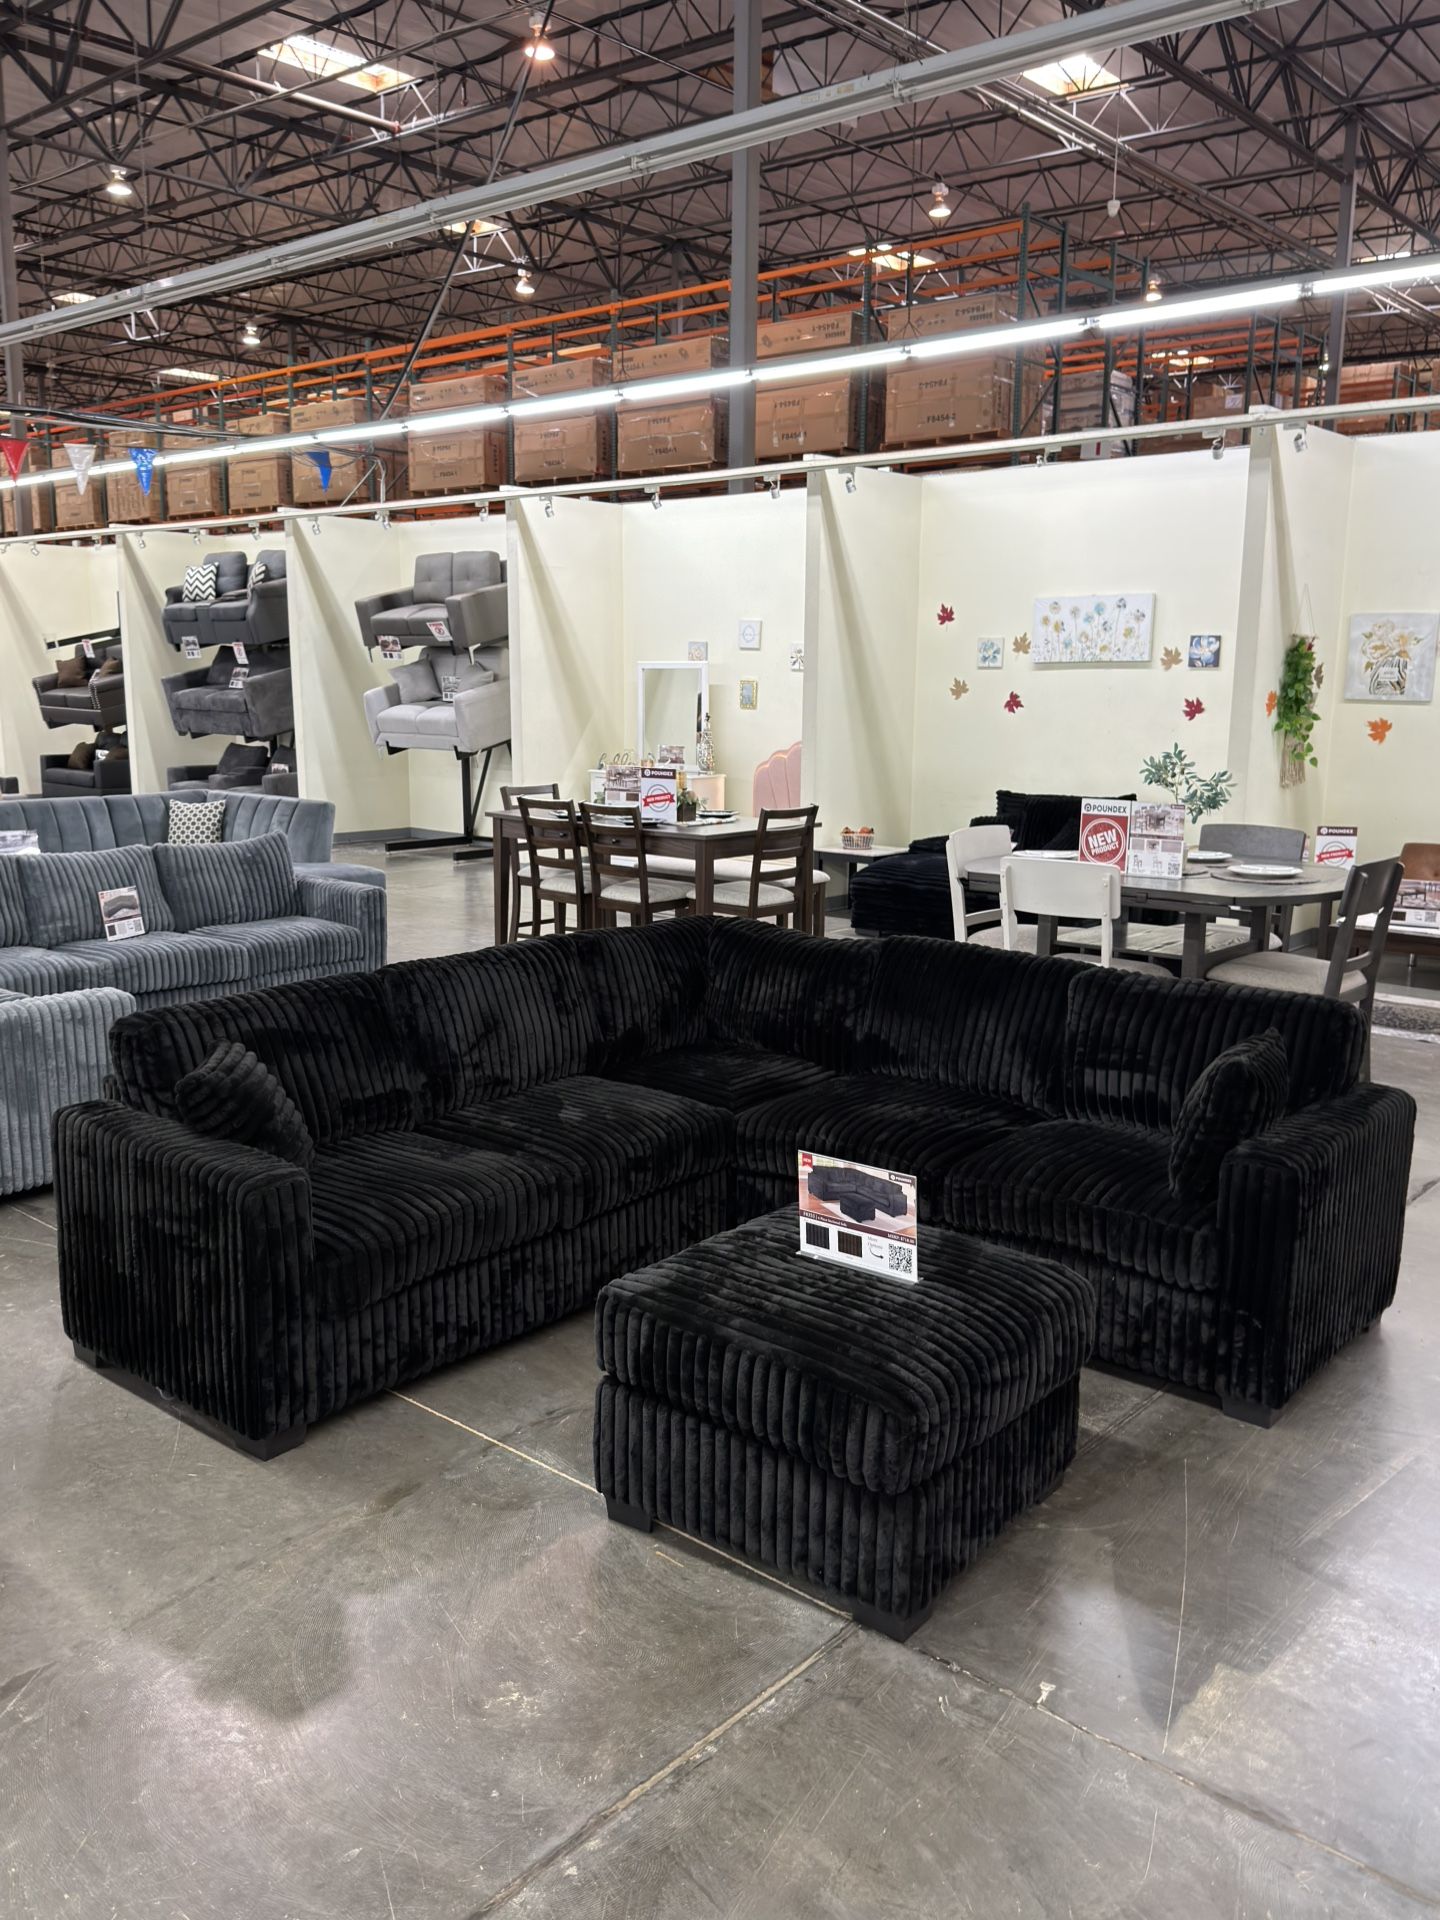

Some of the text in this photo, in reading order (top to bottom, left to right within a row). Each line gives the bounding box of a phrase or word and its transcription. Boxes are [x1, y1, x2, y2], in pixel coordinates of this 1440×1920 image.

[1092, 804, 1127, 814] POUNDEX
[1087, 829, 1117, 849] NEW
[1090, 841, 1119, 856] PRODUCT
